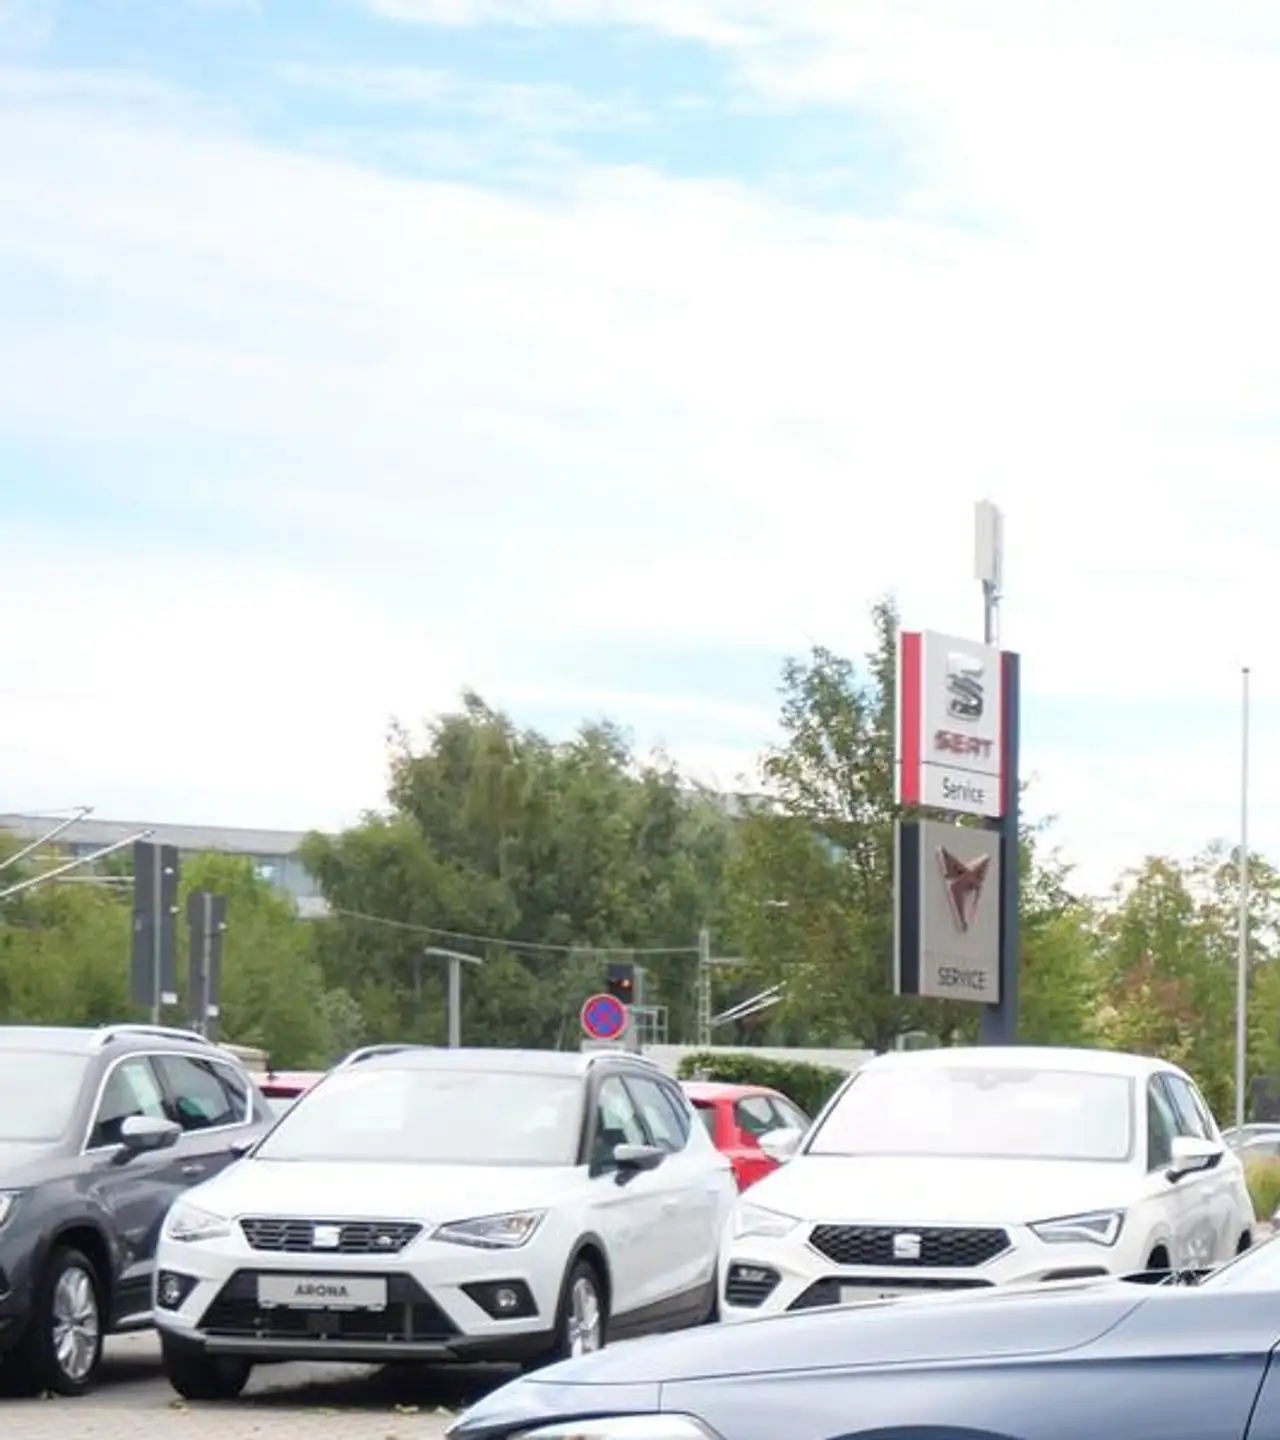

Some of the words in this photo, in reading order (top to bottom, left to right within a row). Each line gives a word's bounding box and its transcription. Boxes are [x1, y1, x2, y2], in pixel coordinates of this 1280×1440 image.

[942, 775, 985, 804] Service
[937, 966, 987, 991] SERVICE
[294, 1284, 349, 1297] ARONA
